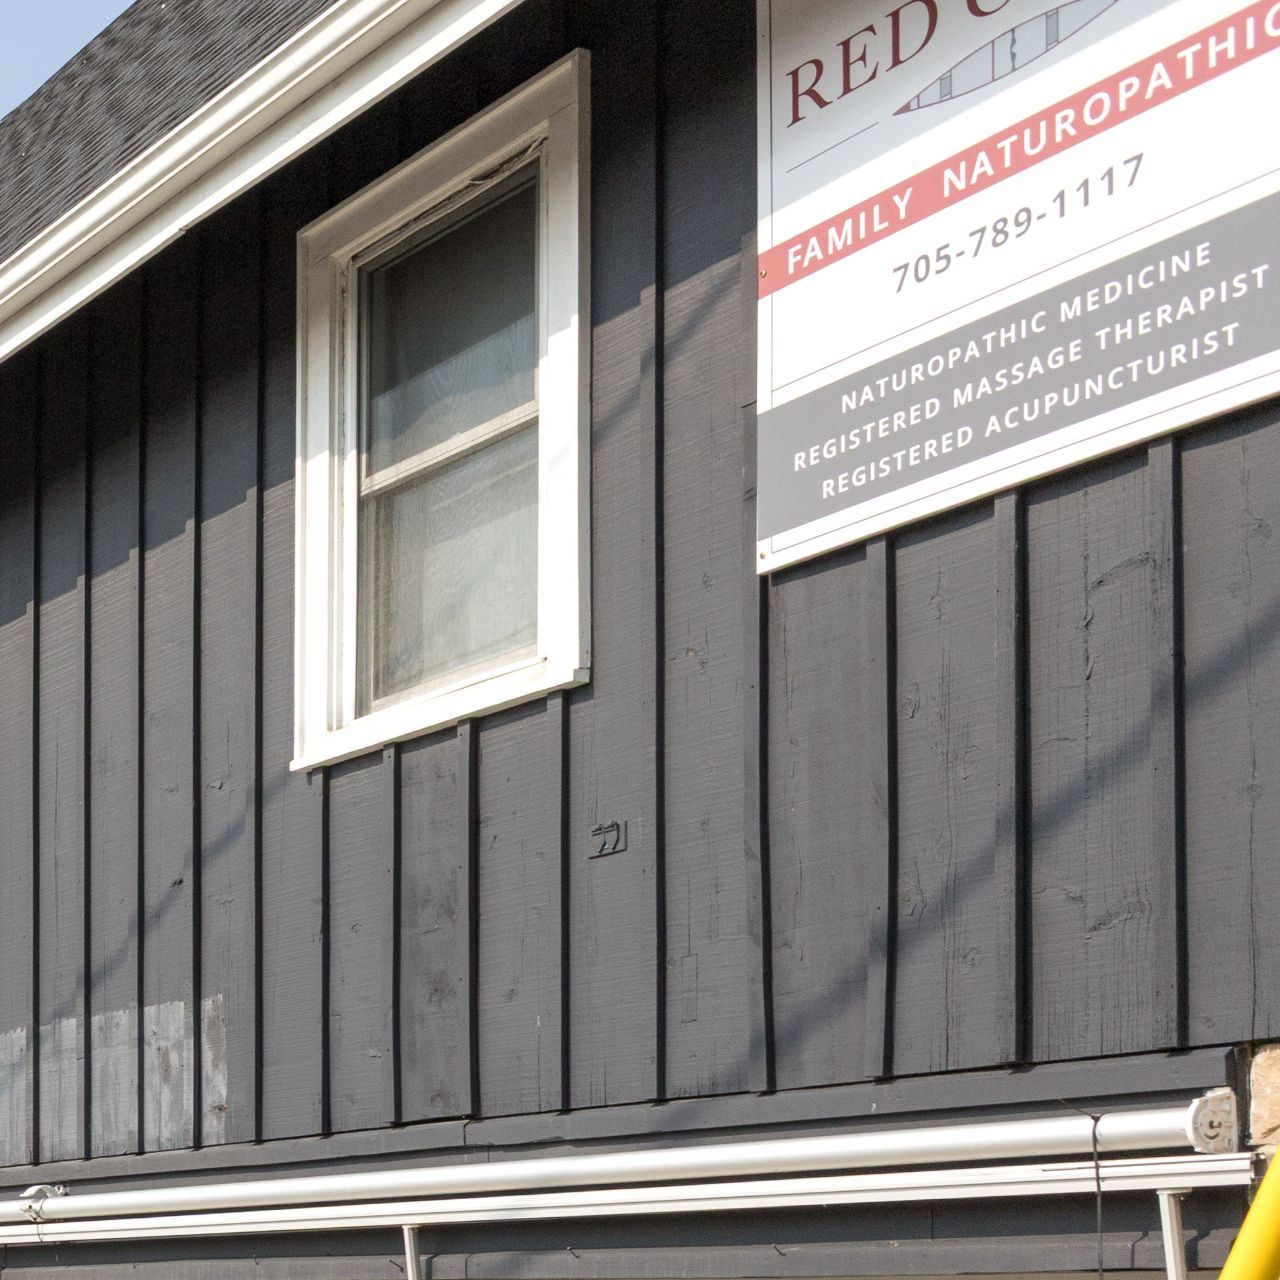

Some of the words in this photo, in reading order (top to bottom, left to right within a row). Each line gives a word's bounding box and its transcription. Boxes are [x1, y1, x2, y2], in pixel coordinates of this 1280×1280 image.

[786, 0, 938, 128] RED
[787, 188, 913, 275] FAMILY
[943, 2, 1280, 198] NATUROPATHIC
[892, 152, 1144, 294] 705-789-1117
[793, 397, 941, 472] REGISTERED
[953, 339, 1083, 407] MASSAGE
[1094, 264, 1270, 351] THERAPIST
[821, 426, 973, 499] REGISTERED
[984, 322, 1240, 438] ACUPUNCTURIST
[841, 310, 1047, 414] NATUROPATHIC
[1060, 242, 1212, 323] MEDICINE
